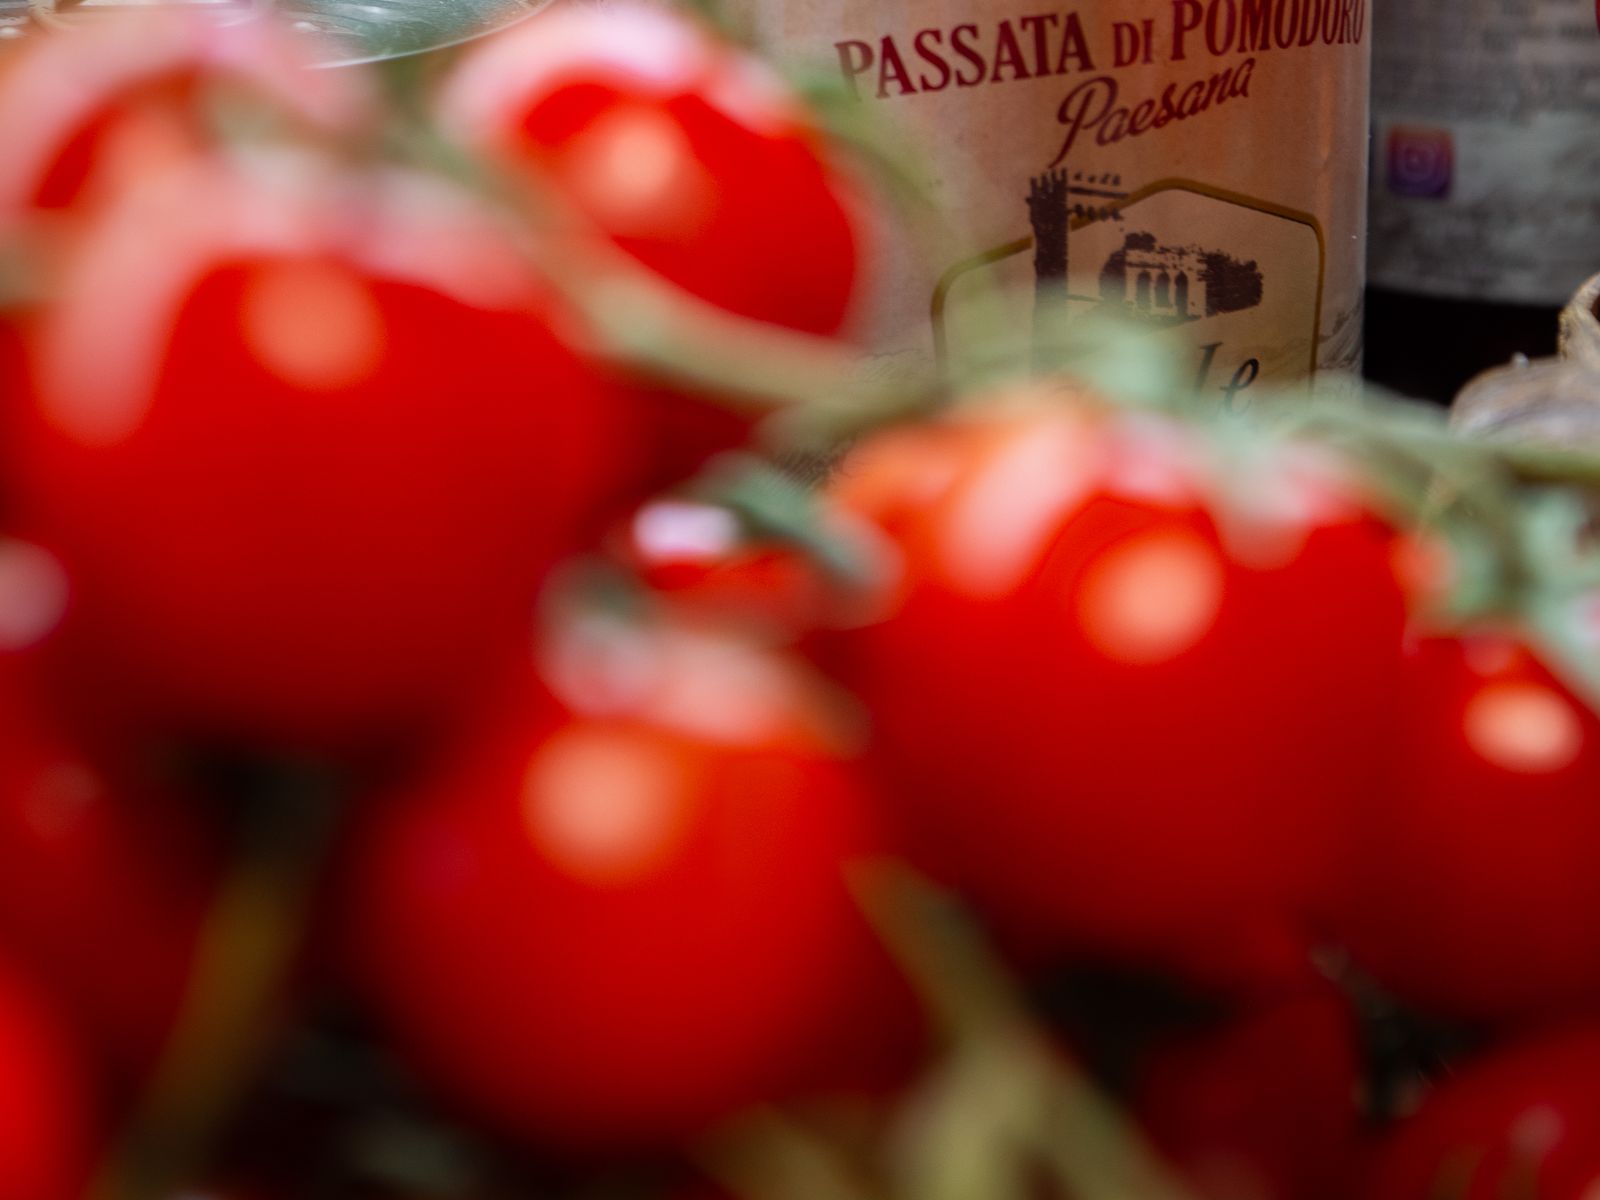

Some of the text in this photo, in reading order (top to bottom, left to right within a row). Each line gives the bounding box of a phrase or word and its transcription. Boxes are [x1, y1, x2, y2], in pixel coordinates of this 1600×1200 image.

[835, 11, 1094, 100] PASSATA
[1112, 19, 1155, 68] DI
[1051, 58, 1256, 168] Paesana
